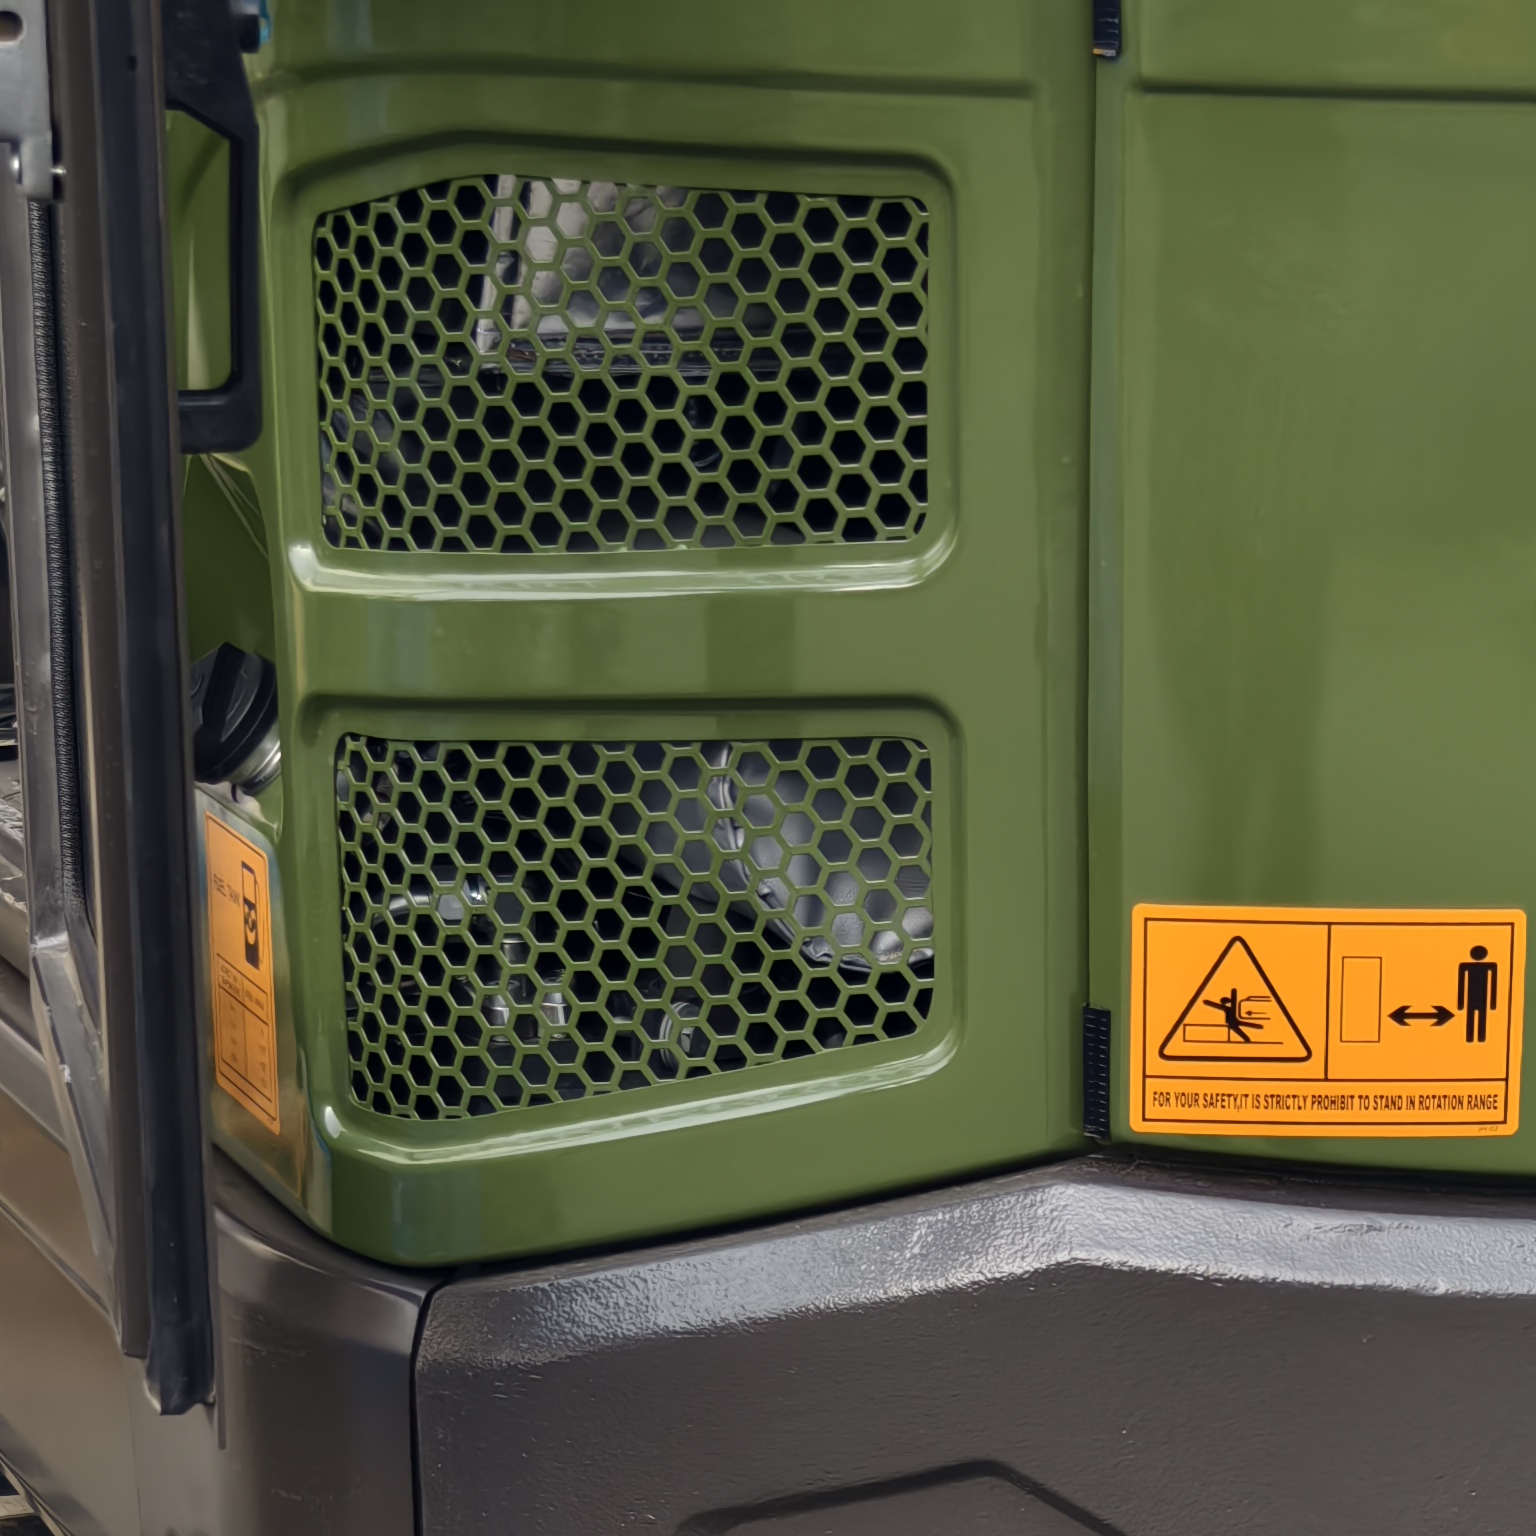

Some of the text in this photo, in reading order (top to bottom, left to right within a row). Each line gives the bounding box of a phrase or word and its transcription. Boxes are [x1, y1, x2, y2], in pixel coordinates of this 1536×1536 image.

[1152, 1091, 1171, 1108] FOR
[1174, 1092, 1200, 1108] YOUR
[1252, 1094, 1261, 1109] IS
[1263, 1094, 1309, 1110] STRICTLY
[1311, 1094, 1355, 1111] PROHIBIT
[1358, 1095, 1370, 1111] TO
[1373, 1095, 1403, 1111] STAND
[1405, 1095, 1415, 1111] IN
[1418, 1094, 1464, 1111] ROTATION
[1467, 1094, 1498, 1110] RANGE
